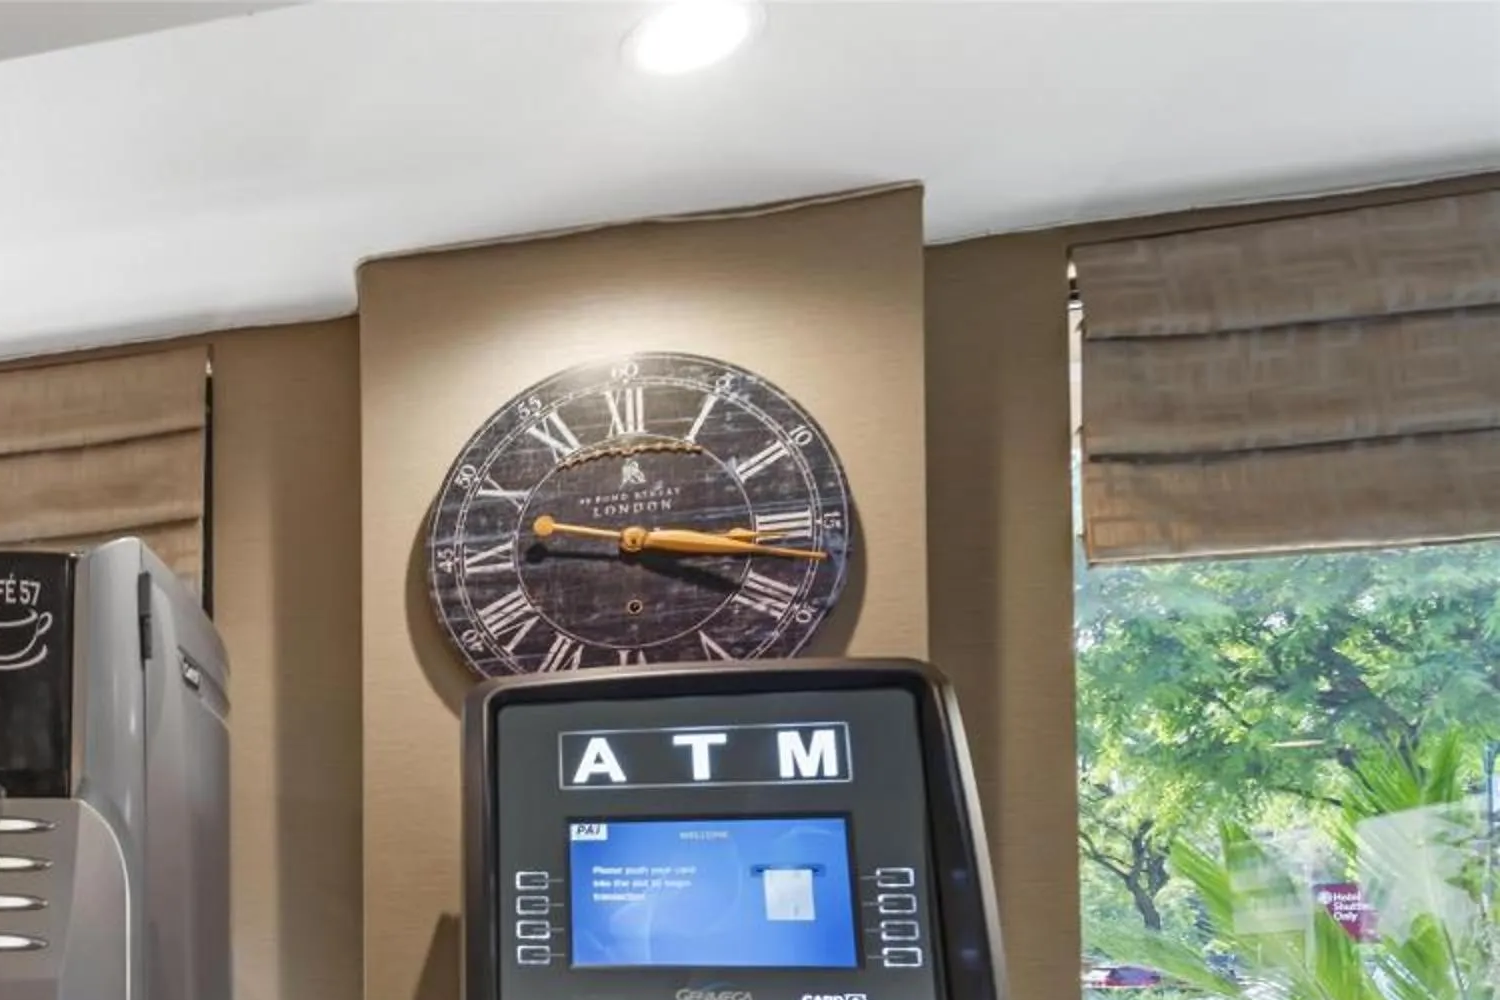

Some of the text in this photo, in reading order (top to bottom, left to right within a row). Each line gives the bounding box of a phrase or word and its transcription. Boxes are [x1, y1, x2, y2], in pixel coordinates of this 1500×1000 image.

[789, 425, 813, 447] 10
[592, 499, 672, 519] LONDON
[19, 580, 41, 606] 57
[572, 729, 840, 784] ATM
[1333, 890, 1362, 901] Hotel
[1332, 911, 1358, 923] Only
